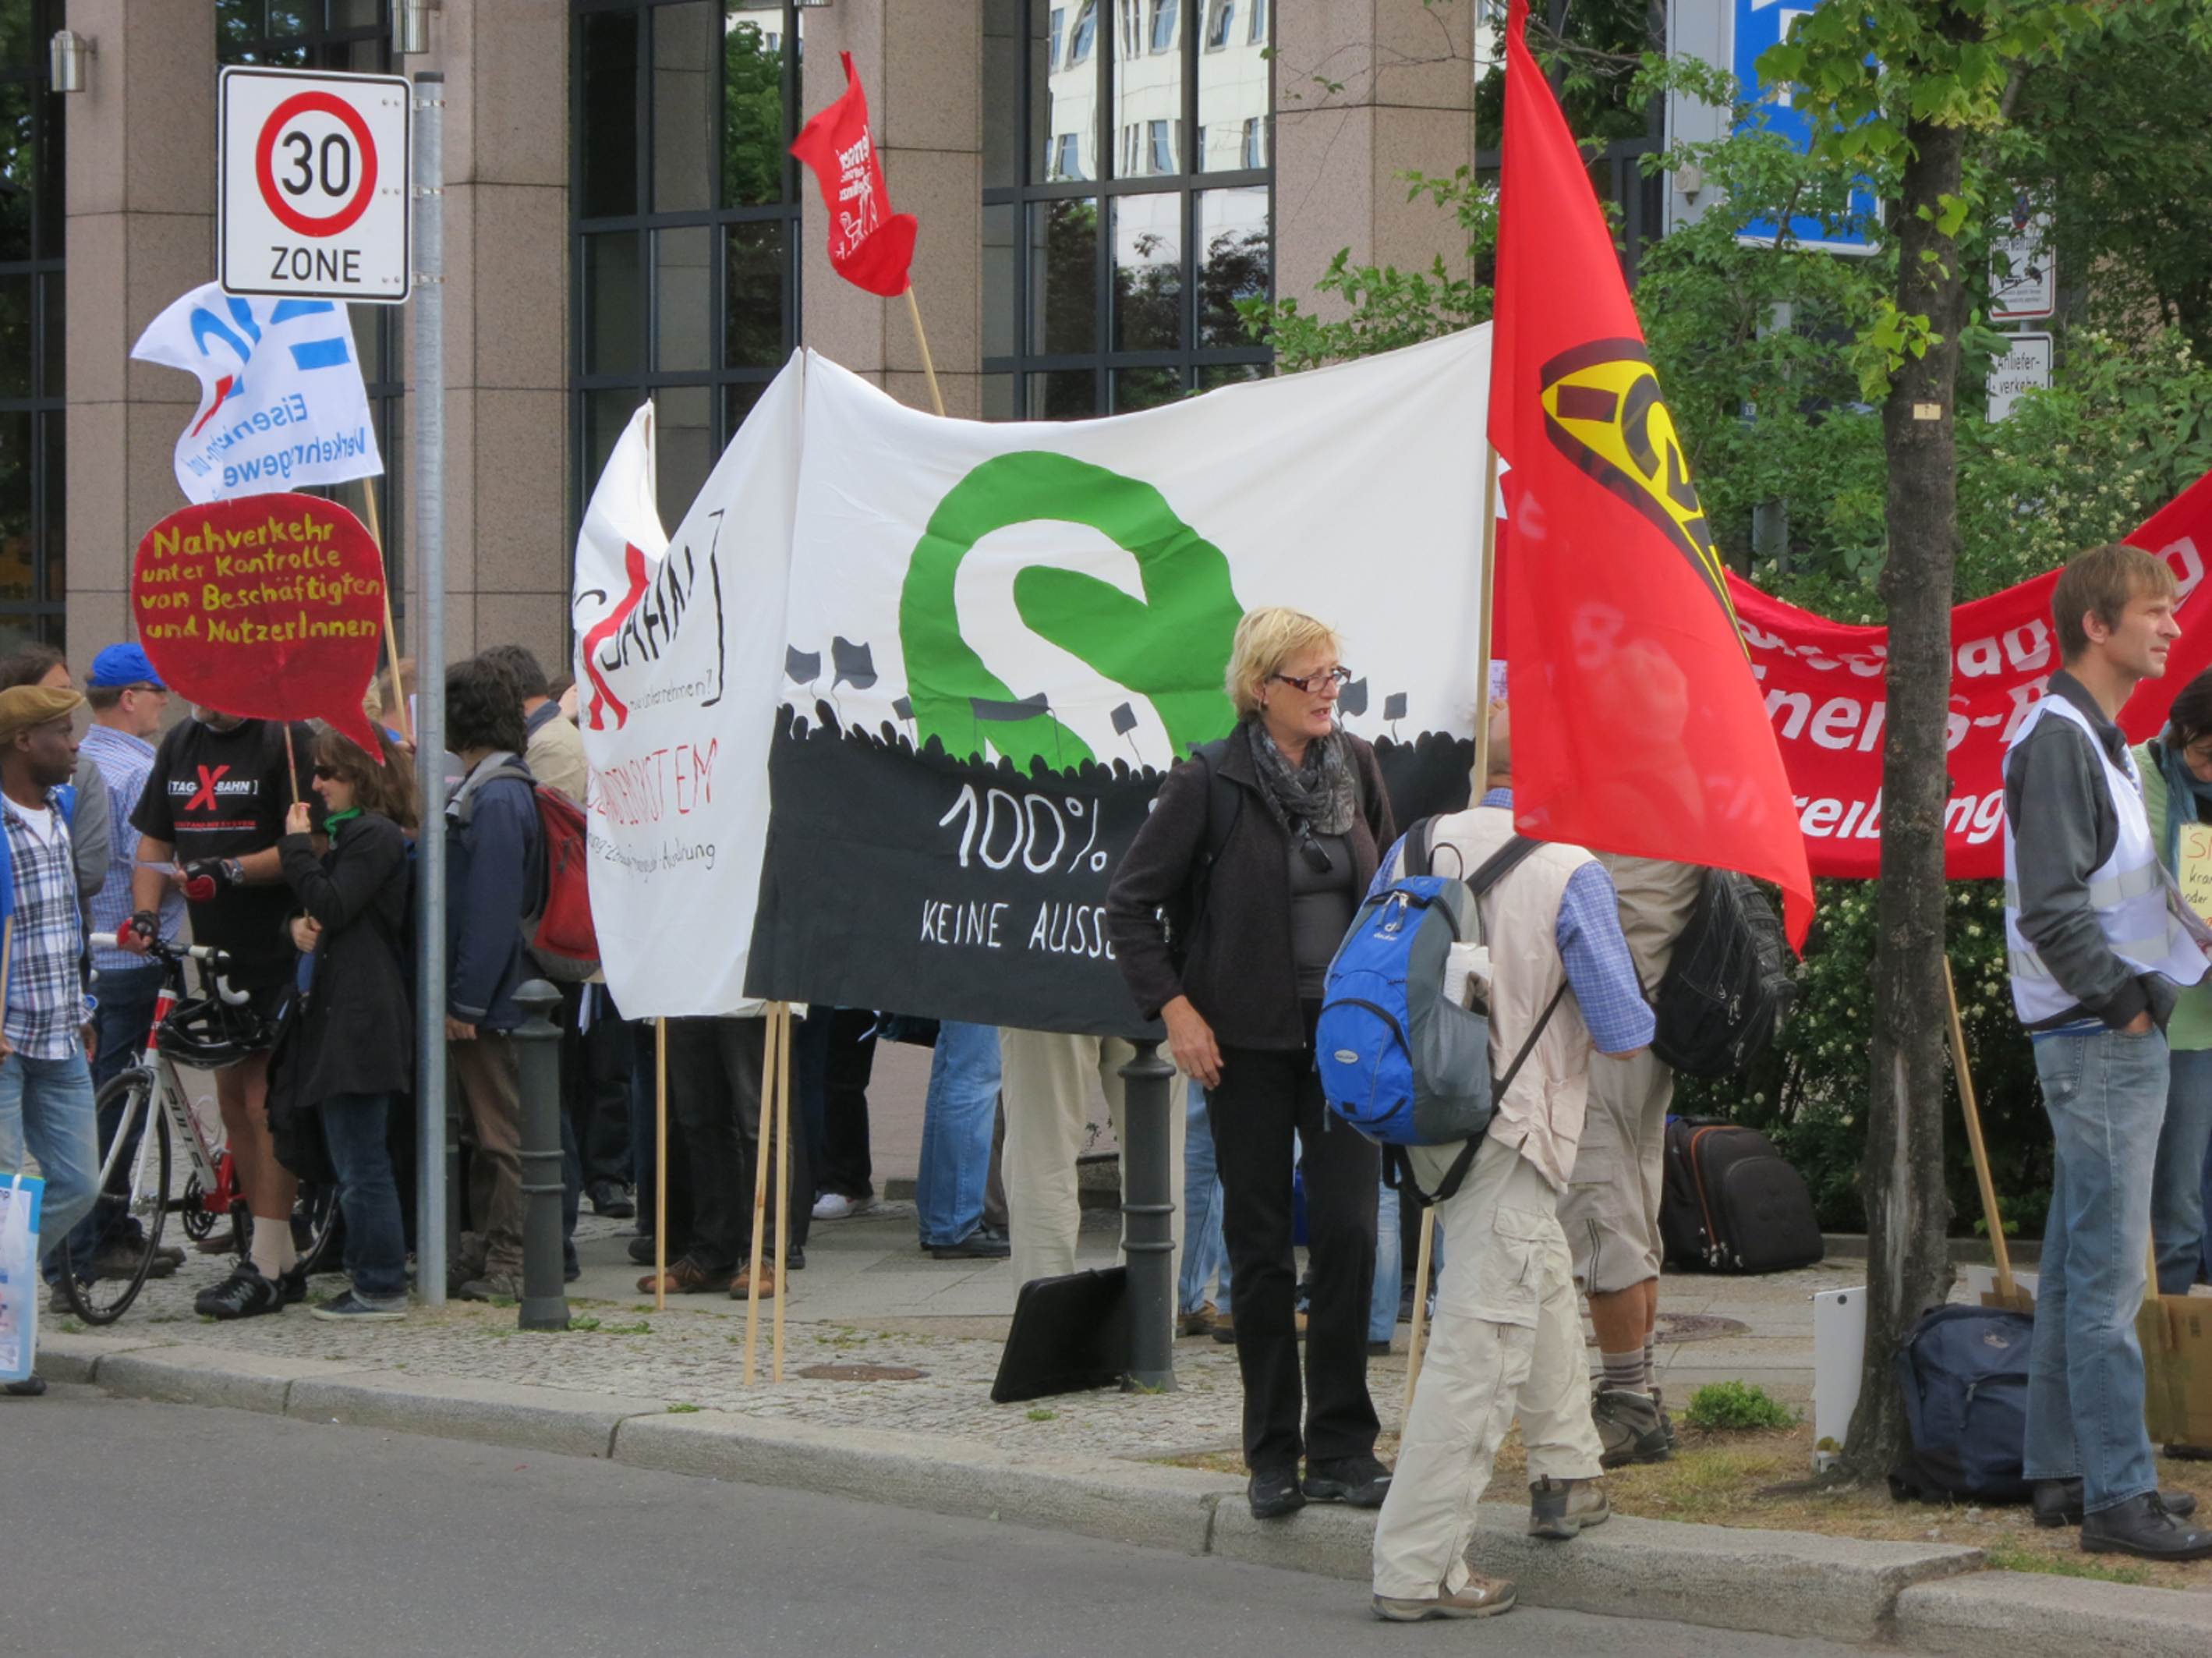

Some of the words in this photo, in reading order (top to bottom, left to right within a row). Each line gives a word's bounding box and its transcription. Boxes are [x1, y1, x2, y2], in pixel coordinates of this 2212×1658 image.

[281, 130, 351, 197] 30
[271, 246, 361, 283] ZONE
[154, 513, 334, 558] Nahverkehr
[141, 562, 204, 583] unter
[215, 547, 341, 577] Kontrolle
[140, 590, 189, 609] von
[202, 572, 380, 611] Beschäftigten
[146, 615, 199, 639] und
[207, 610, 377, 644] NutzerInnen
[185, 764, 230, 810] X
[939, 784, 1107, 873] 100%
[920, 899, 1009, 948] KEINE
